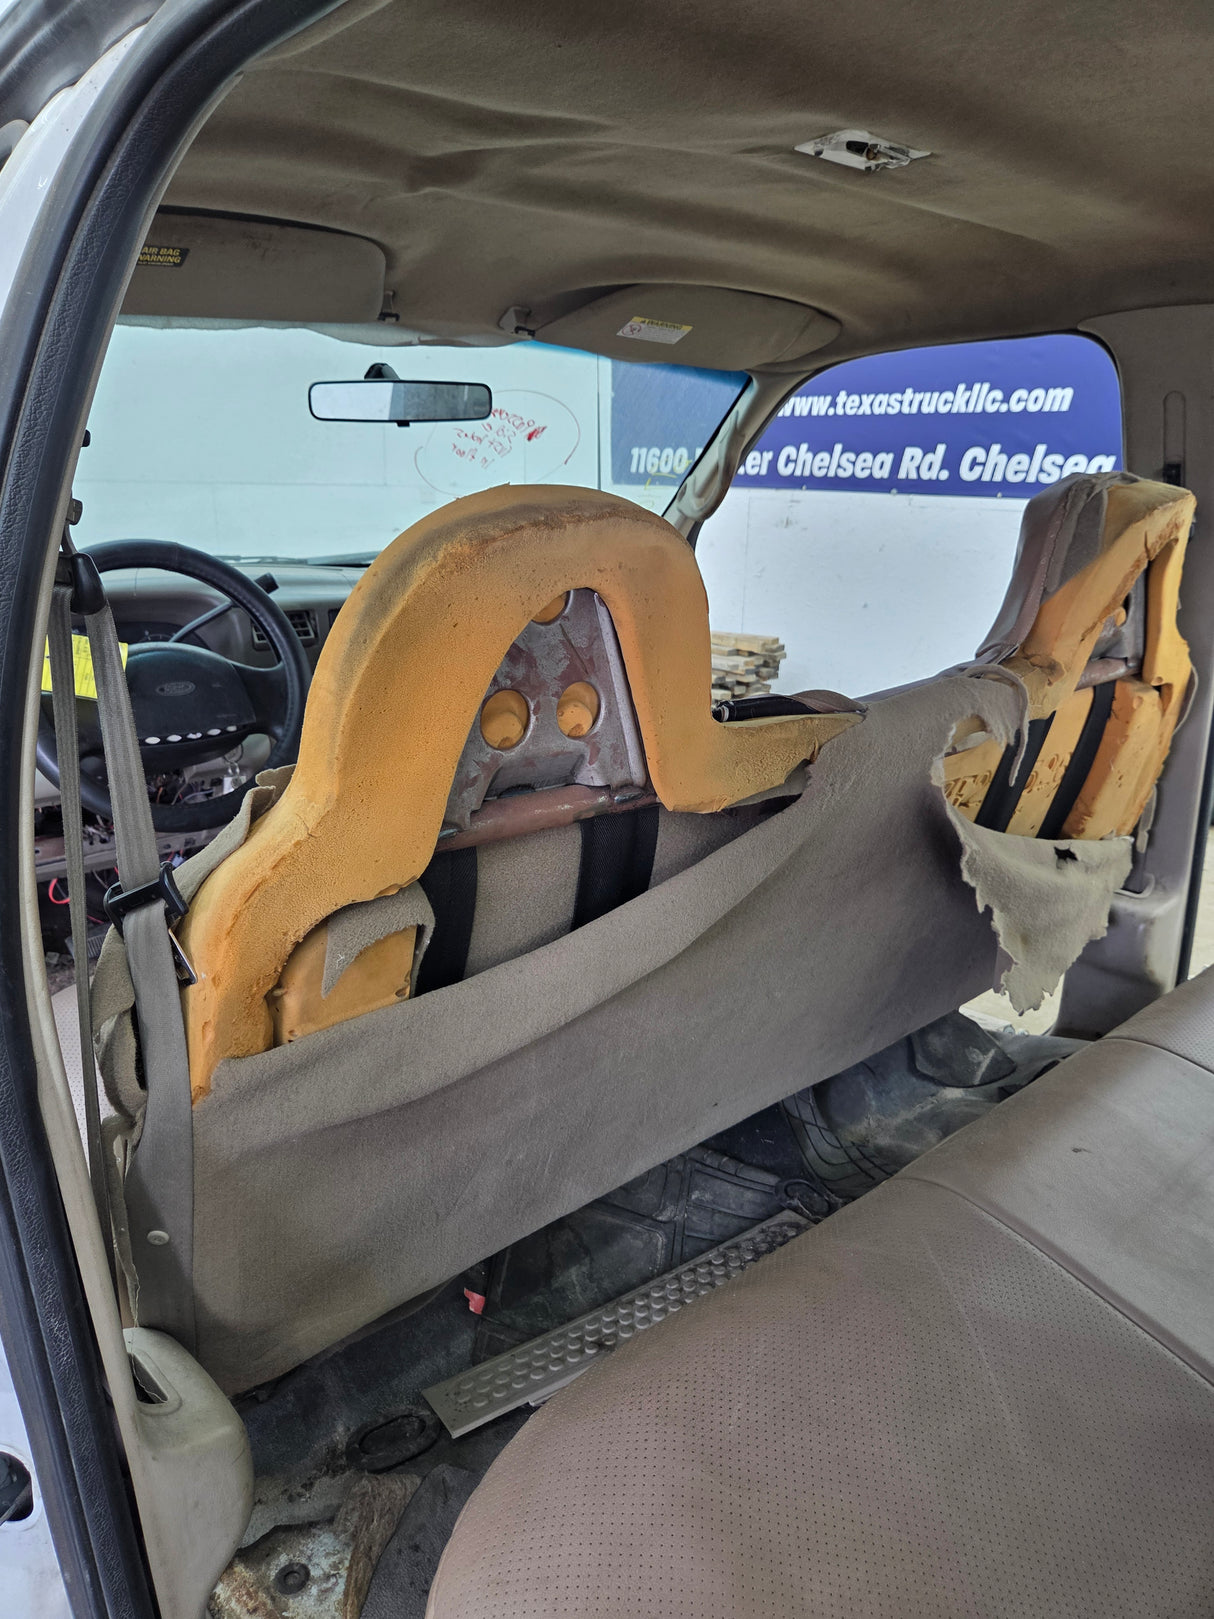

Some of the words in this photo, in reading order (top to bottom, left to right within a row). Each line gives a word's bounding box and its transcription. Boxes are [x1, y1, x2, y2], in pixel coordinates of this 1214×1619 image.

[142, 246, 158, 255] AIR
[160, 247, 180, 256] BAG
[777, 381, 1075, 417] www.texastruckllc.com
[629, 446, 689, 474] 11600
[777, 442, 895, 479] Chelsea
[897, 443, 950, 480] Rd.
